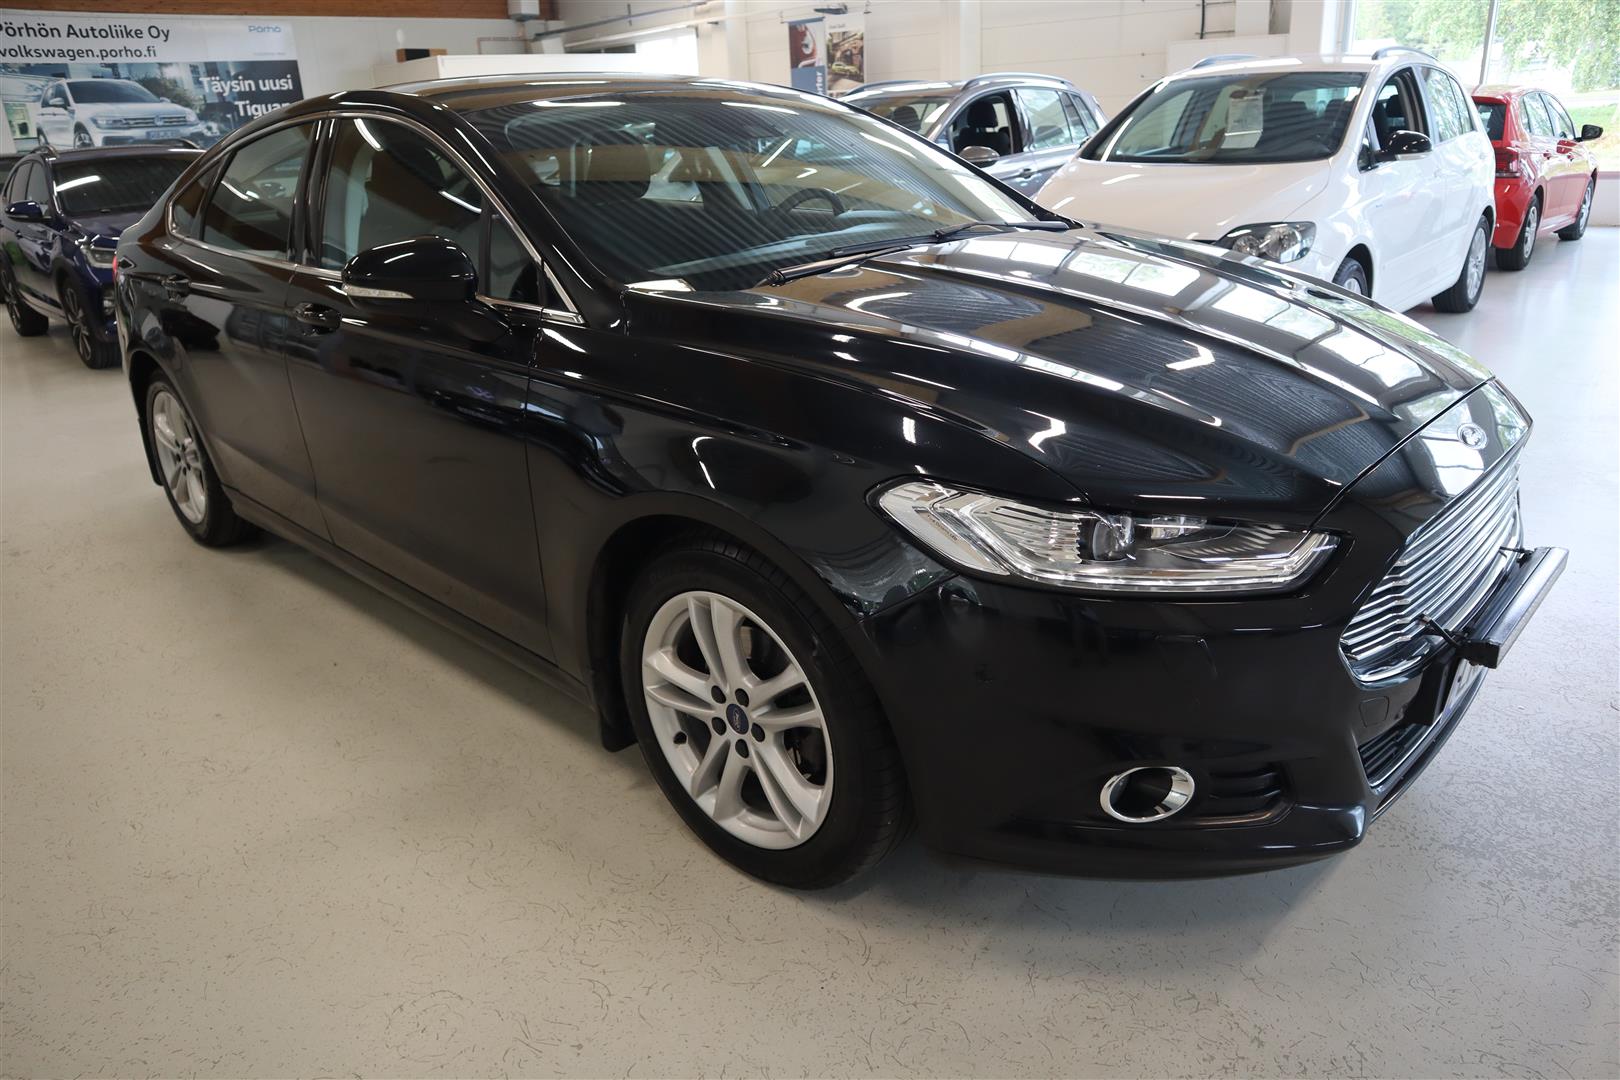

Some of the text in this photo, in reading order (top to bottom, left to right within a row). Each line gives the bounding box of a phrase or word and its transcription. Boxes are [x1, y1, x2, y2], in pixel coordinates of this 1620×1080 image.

[66, 24, 143, 39] Autoliike
[147, 25, 170, 42] Oy
[0, 44, 157, 61] volkswagen.porho.fi
[199, 73, 293, 96] Täysin uusi
[234, 100, 291, 119] Tigua
